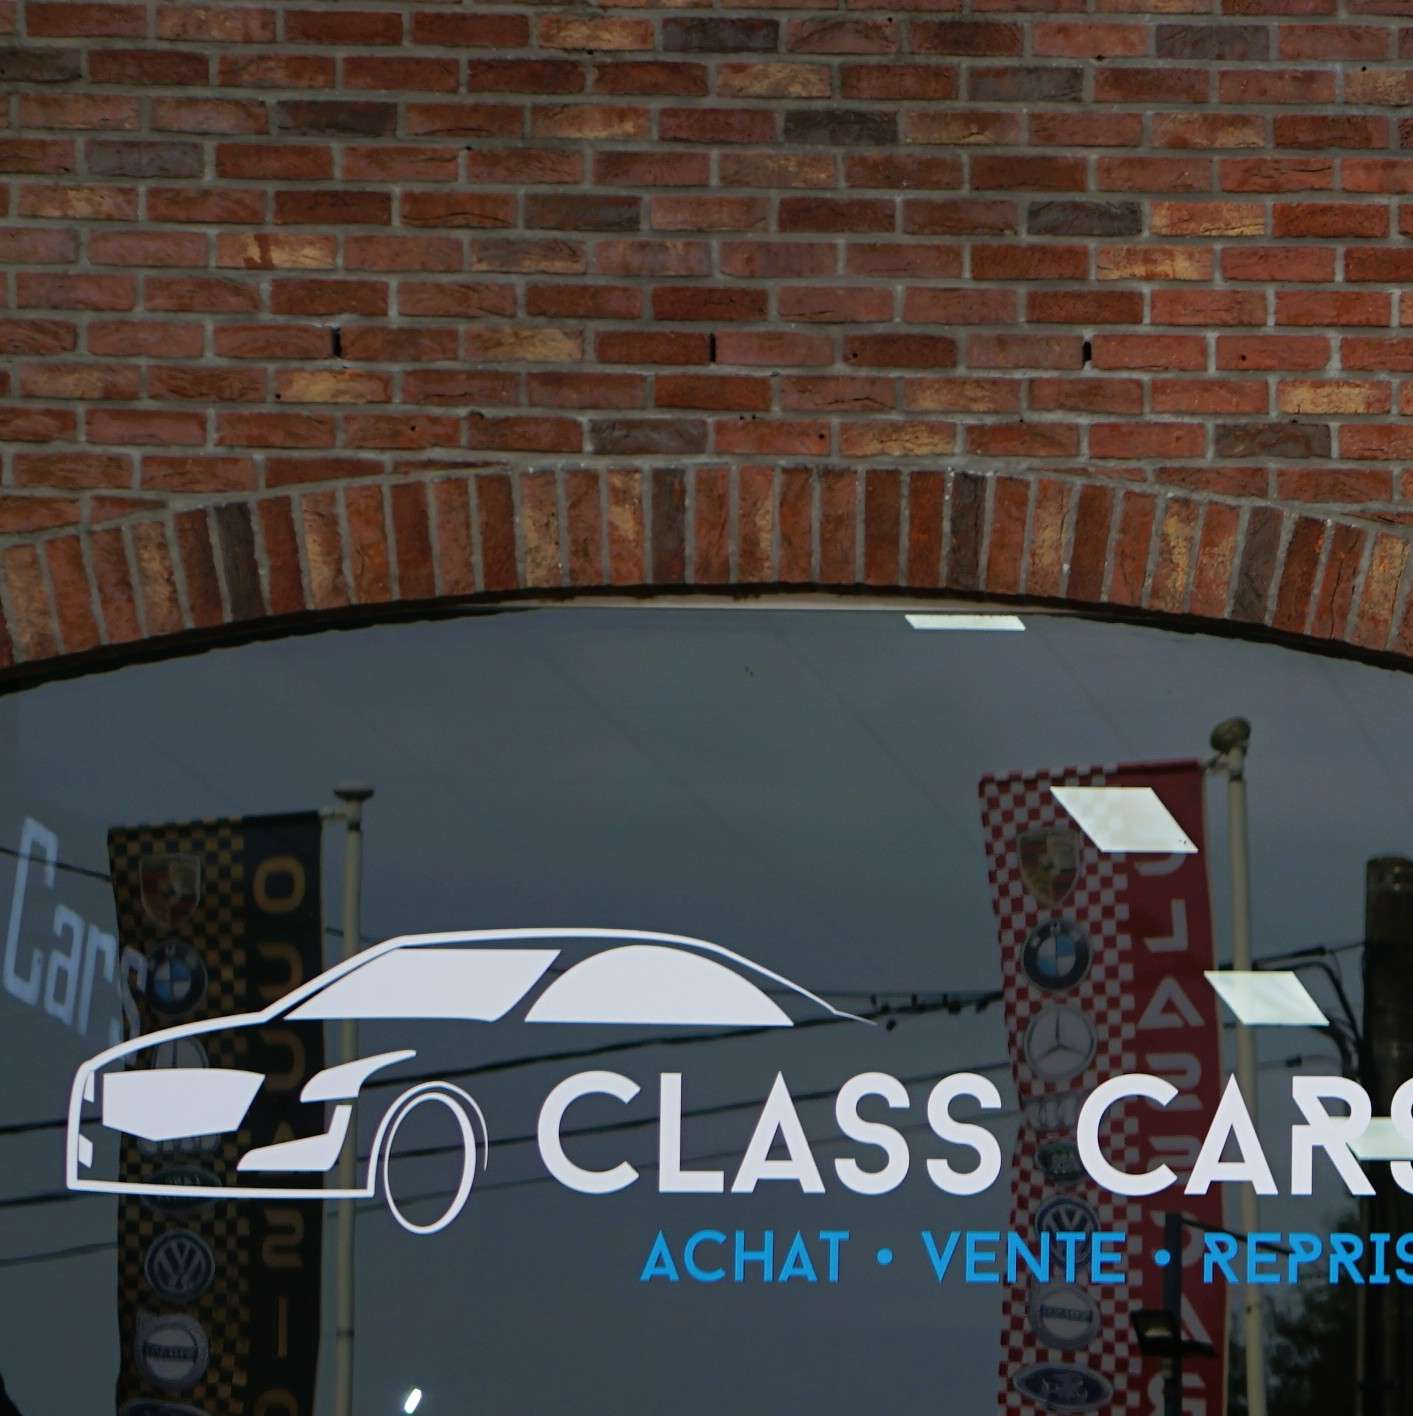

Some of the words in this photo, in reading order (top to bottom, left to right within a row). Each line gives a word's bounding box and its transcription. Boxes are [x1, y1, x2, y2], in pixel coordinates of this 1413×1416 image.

[538, 1071, 1002, 1196] CLASS
[640, 1229, 851, 1284] ACHAT
[920, 1231, 1127, 1285] VENTE
